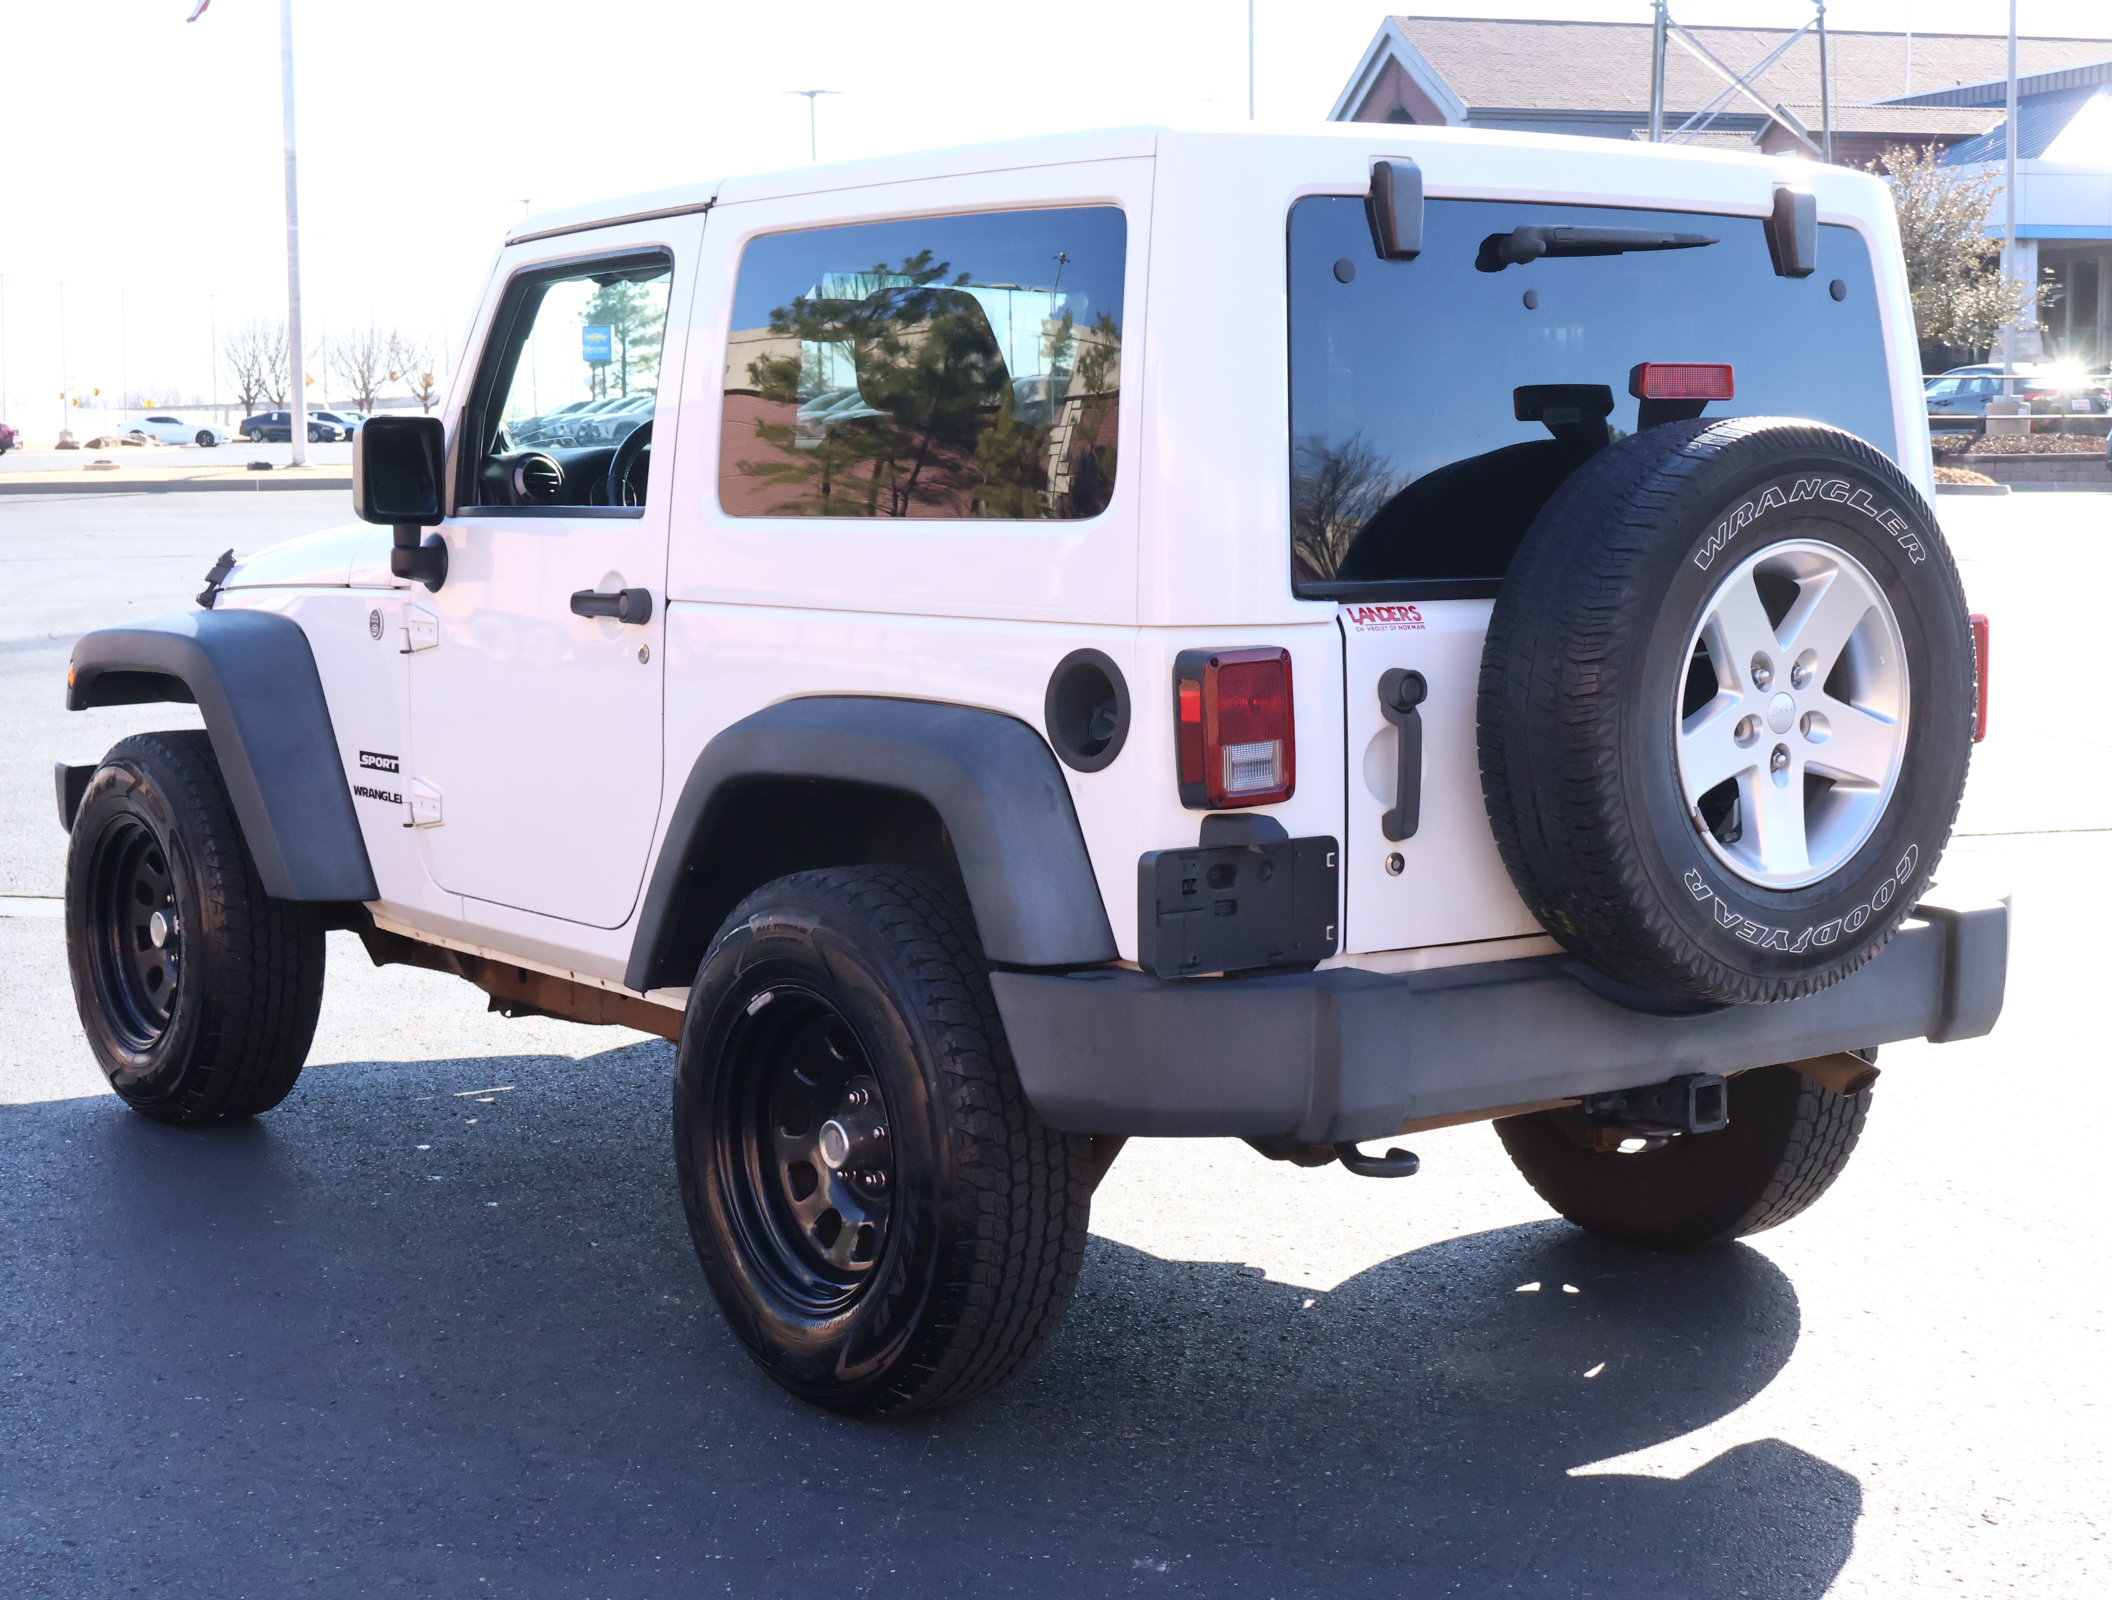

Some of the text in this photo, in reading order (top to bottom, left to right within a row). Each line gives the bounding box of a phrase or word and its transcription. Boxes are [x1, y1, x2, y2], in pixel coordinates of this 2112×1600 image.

[1693, 478, 1927, 571] WRANGLER
[1346, 605, 1422, 625] LANDERS
[360, 754, 400, 770] SPORT
[1684, 843, 1920, 953] GOODYEAR
